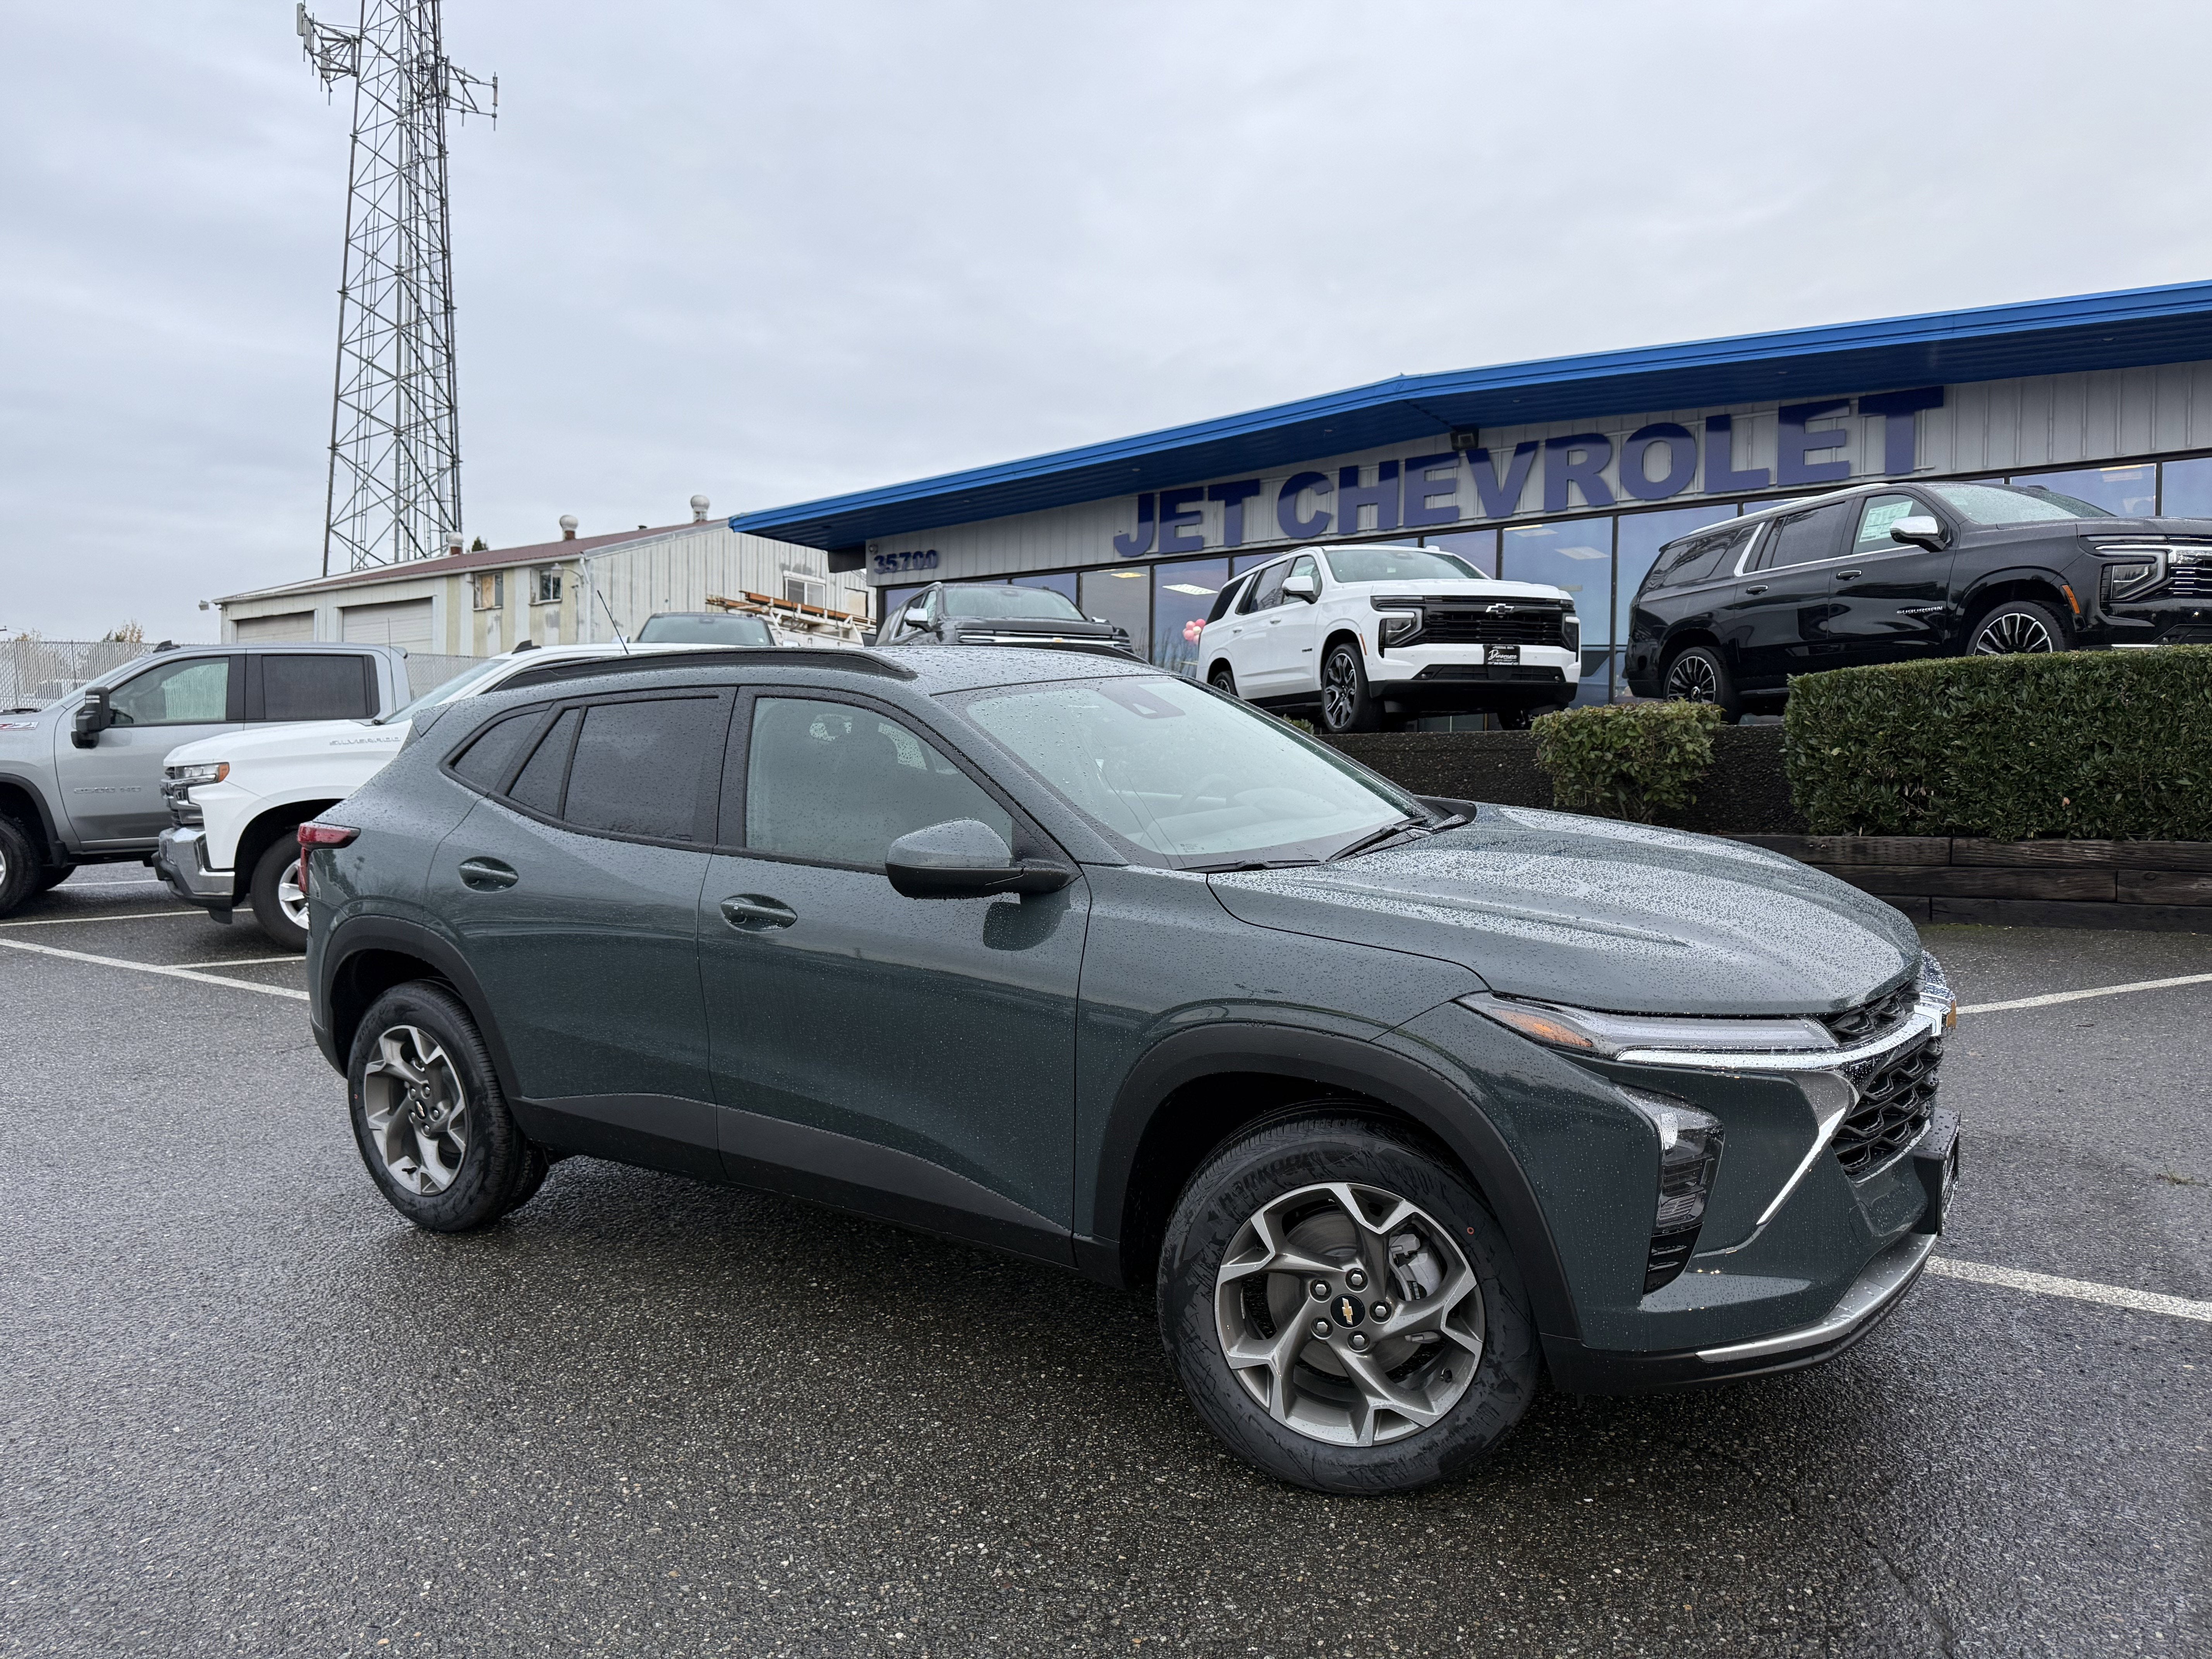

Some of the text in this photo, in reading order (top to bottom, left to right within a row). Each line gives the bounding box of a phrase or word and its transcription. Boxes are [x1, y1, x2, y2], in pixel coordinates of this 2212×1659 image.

[1113, 385, 1944, 557] JET CHEVROLET
[874, 550, 938, 574] 35700
[1897, 606, 1943, 615] SUBURBAN
[330, 737, 401, 746] SILVERADO
